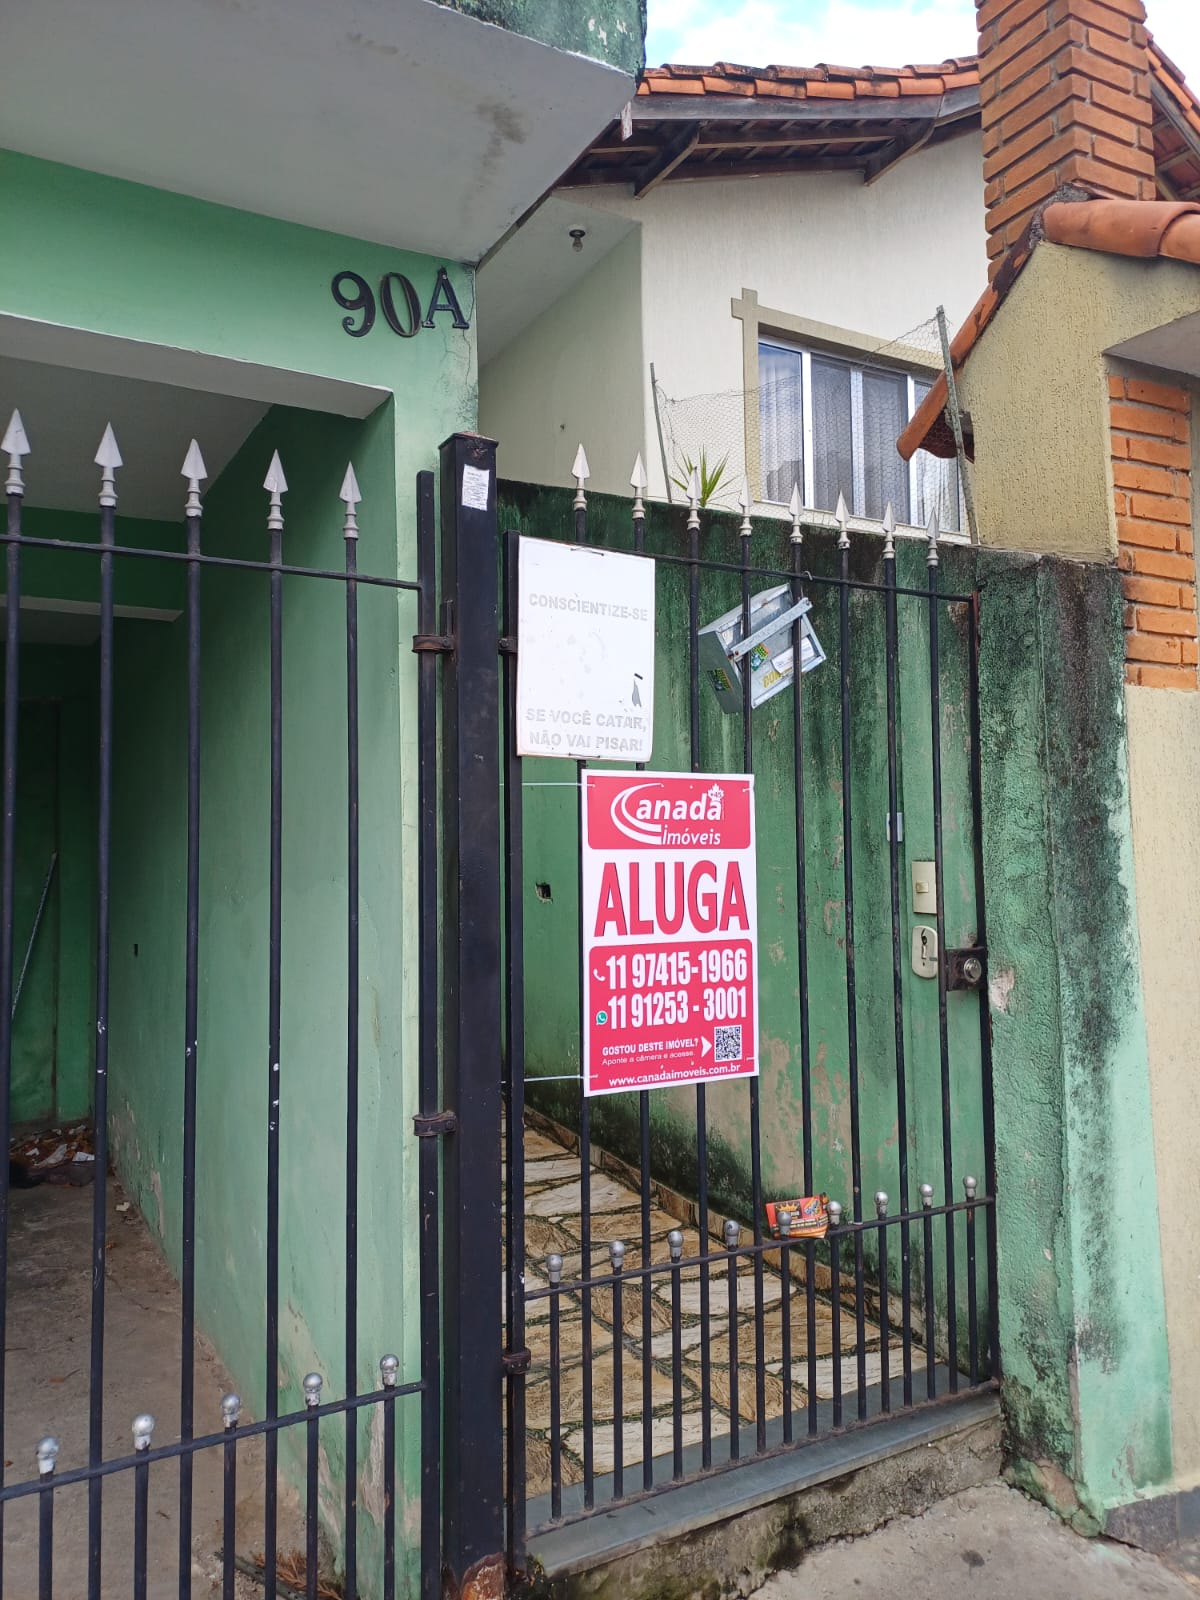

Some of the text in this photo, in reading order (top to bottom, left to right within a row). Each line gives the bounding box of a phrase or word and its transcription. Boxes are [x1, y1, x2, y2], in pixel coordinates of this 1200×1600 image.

[331, 266, 470, 338] 90A
[528, 593, 649, 621] CONSCIENTIZE-SE
[525, 707, 546, 722] SE
[551, 709, 591, 726] VOCÊ
[529, 730, 643, 752] NÃO VAI PISAR!
[662, 825, 721, 845] imóveis
[594, 860, 750, 937] ALUGA
[606, 948, 747, 989] 11 97415-1966
[608, 995, 627, 1029] 11
[631, 990, 689, 1028] 91253
[703, 986, 747, 1021] 3001
[602, 1037, 699, 1056] GOSTOU DESTE IMÓVEL?
[602, 1056, 628, 1066] Aponte
[635, 1053, 662, 1062] câmera
[608, 1062, 741, 1087] www.canadaimoveis.com.br
